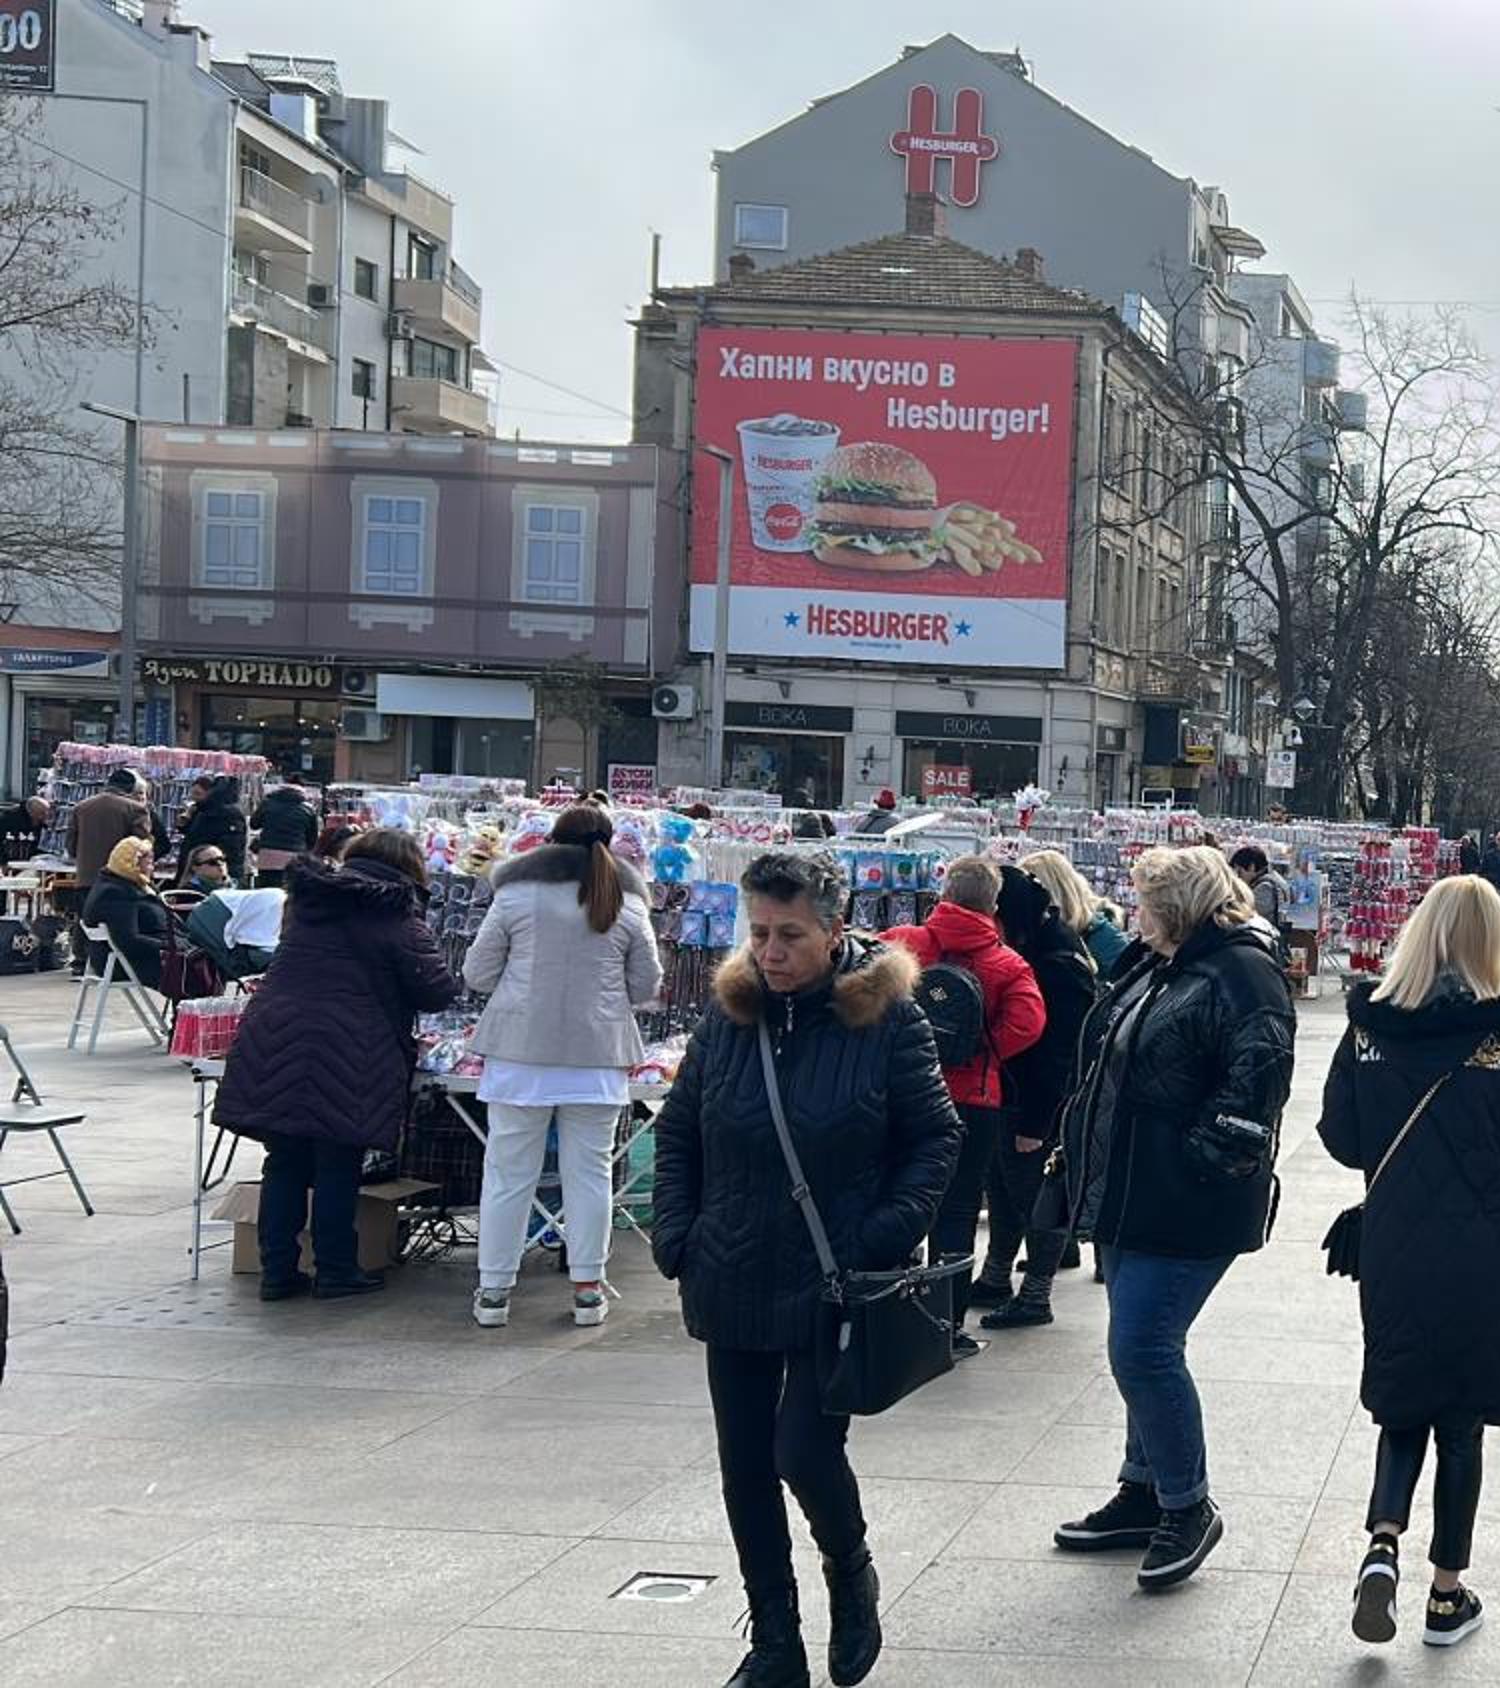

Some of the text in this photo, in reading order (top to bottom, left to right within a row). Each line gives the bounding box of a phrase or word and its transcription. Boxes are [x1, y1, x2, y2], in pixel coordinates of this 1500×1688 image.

[909, 136, 979, 155] HESBURGER
[719, 346, 956, 392] Хапни вкусно в
[887, 397, 1049, 441] Hesburger!
[757, 455, 813, 471] HESBURGER
[807, 603, 949, 646] HESBURGER
[924, 769, 970, 787] SALE
